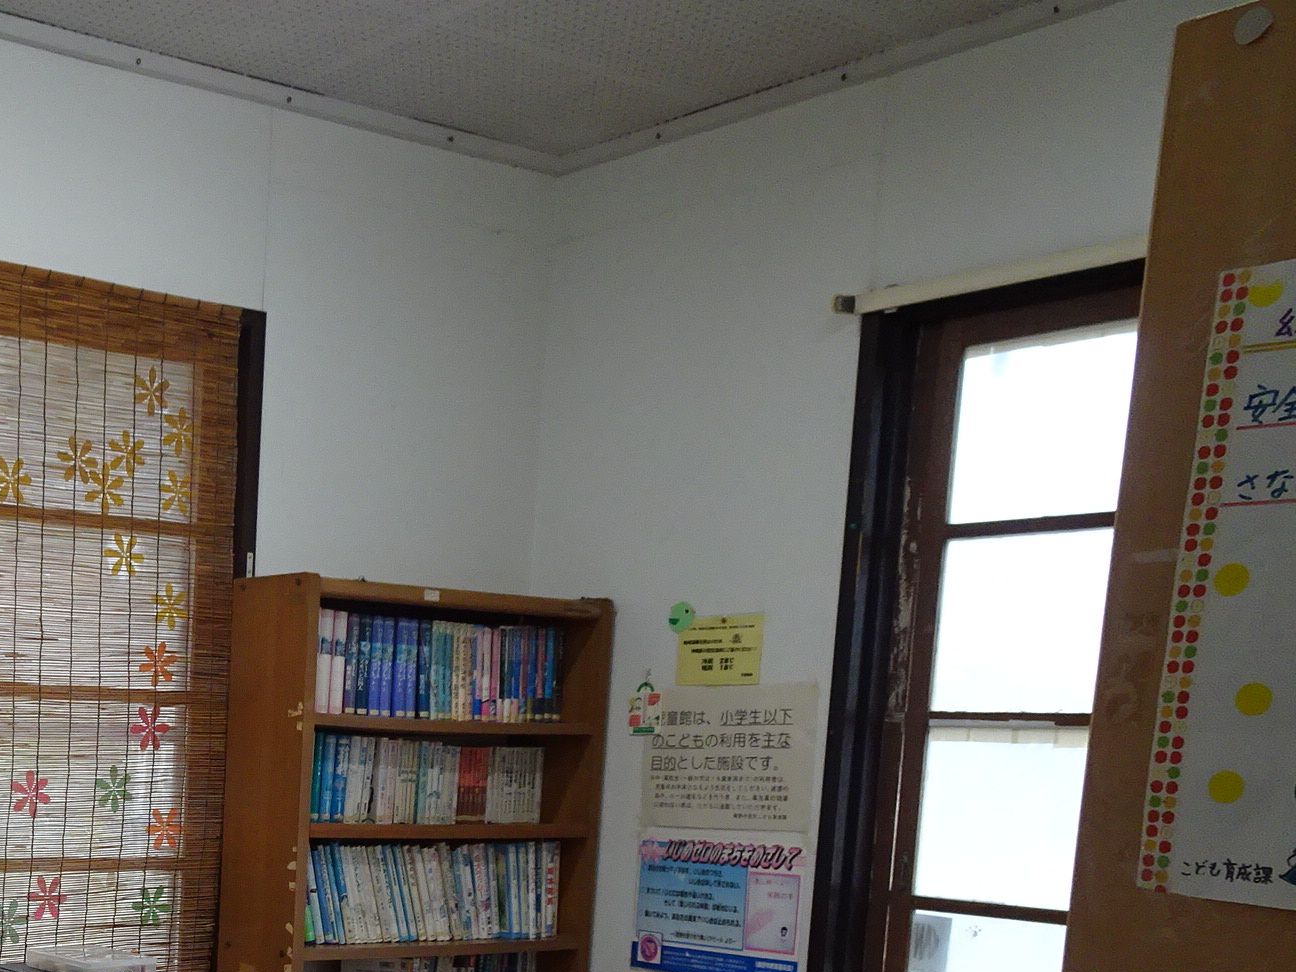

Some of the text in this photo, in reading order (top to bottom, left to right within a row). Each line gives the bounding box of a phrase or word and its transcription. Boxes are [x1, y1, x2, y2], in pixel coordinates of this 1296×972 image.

[651, 732, 792, 749] のこどもの利用を主な
[1181, 858, 1274, 885] こども育成課
